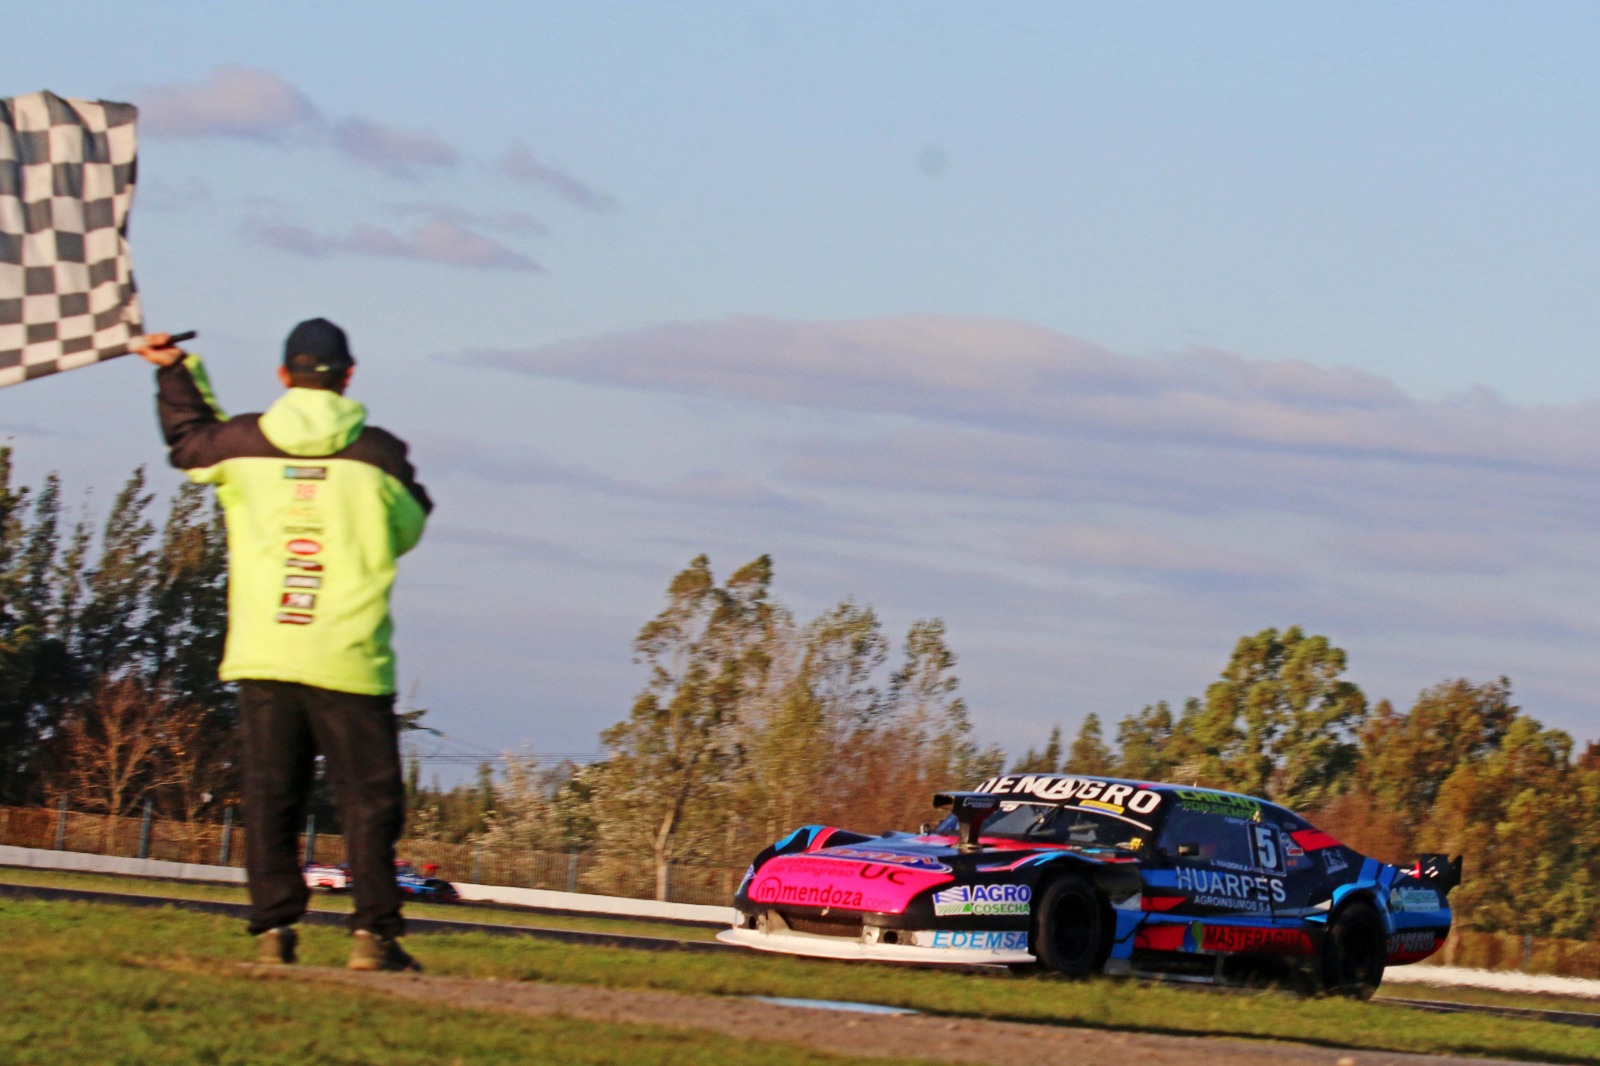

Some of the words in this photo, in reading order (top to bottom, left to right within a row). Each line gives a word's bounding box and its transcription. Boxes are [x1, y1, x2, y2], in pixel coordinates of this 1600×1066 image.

[1254, 826, 1278, 870] 5
[973, 884, 1031, 902] AGRO
[1175, 866, 1287, 902] HUARPES
[973, 902, 1030, 915] COSECHA
[1193, 894, 1258, 911] AGROINSUMOS
[932, 930, 1028, 949] EDEMSA
